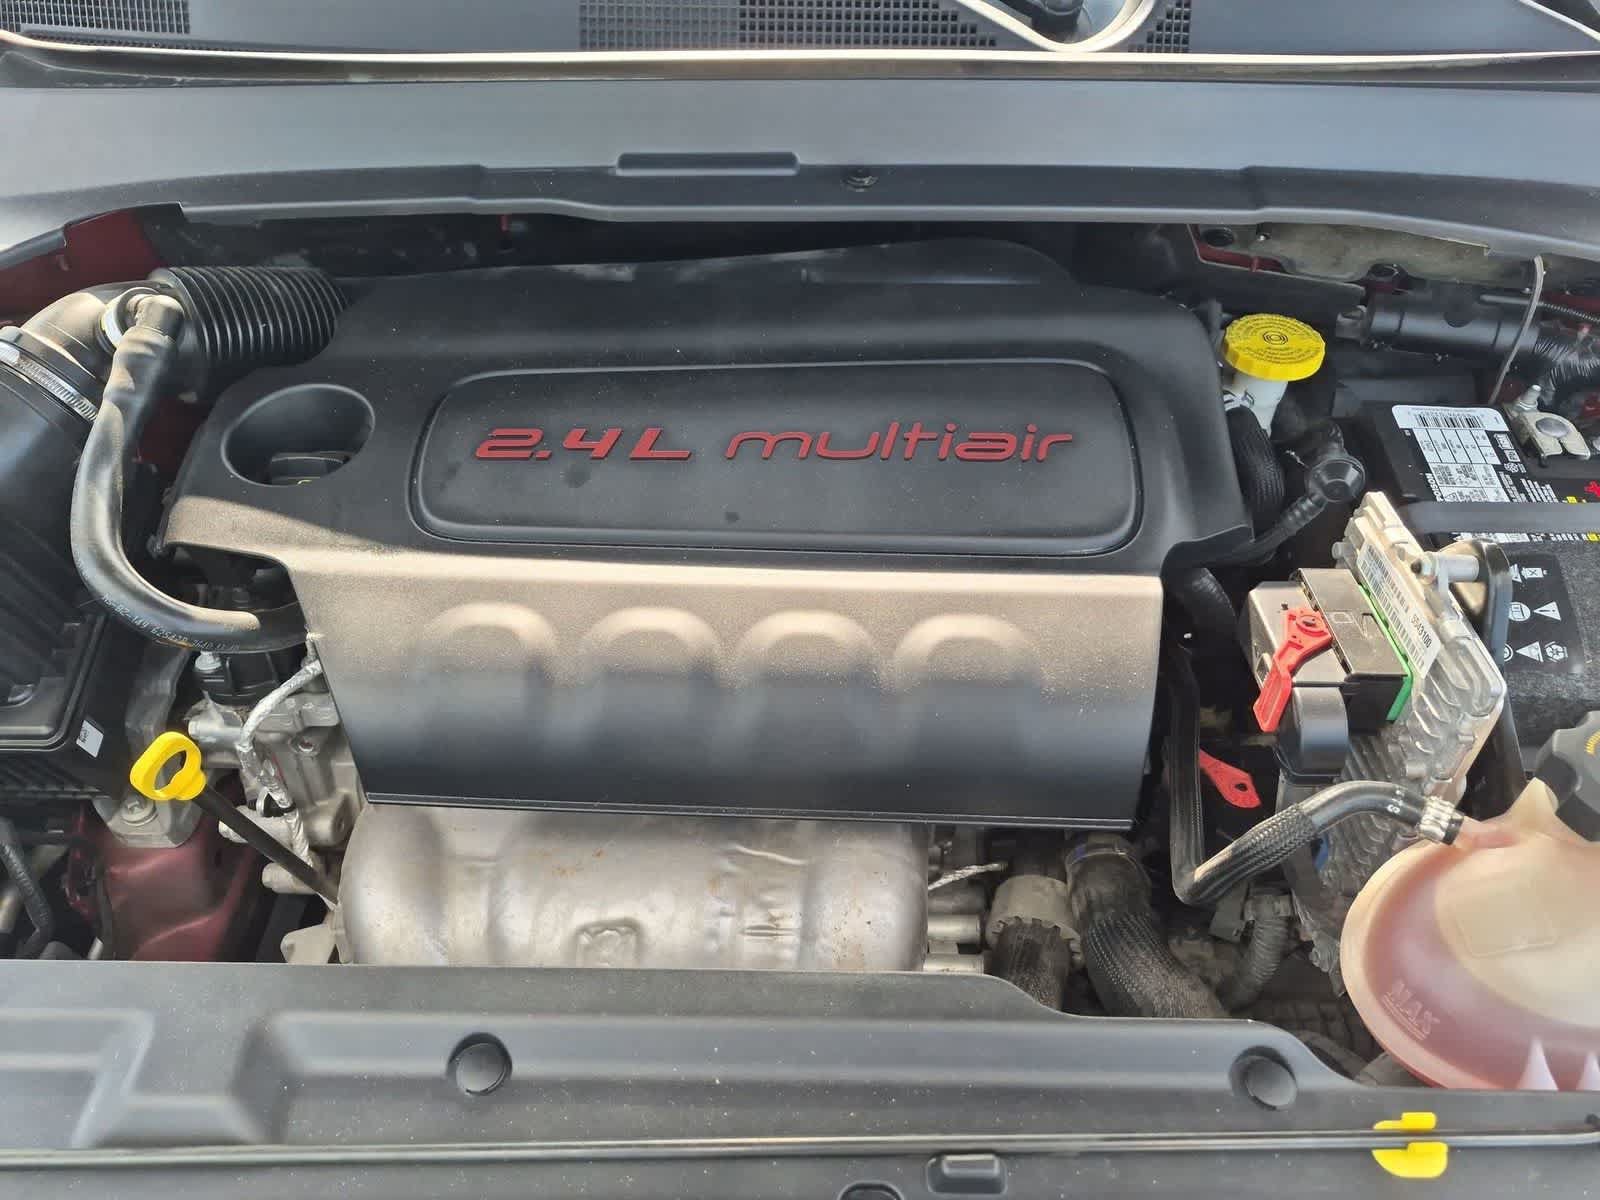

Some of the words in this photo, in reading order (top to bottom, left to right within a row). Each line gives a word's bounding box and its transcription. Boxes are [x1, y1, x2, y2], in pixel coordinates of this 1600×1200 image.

[475, 427, 691, 461] 2.4L
[725, 421, 1073, 462] multiair
[1387, 979, 1441, 1035] MAX
